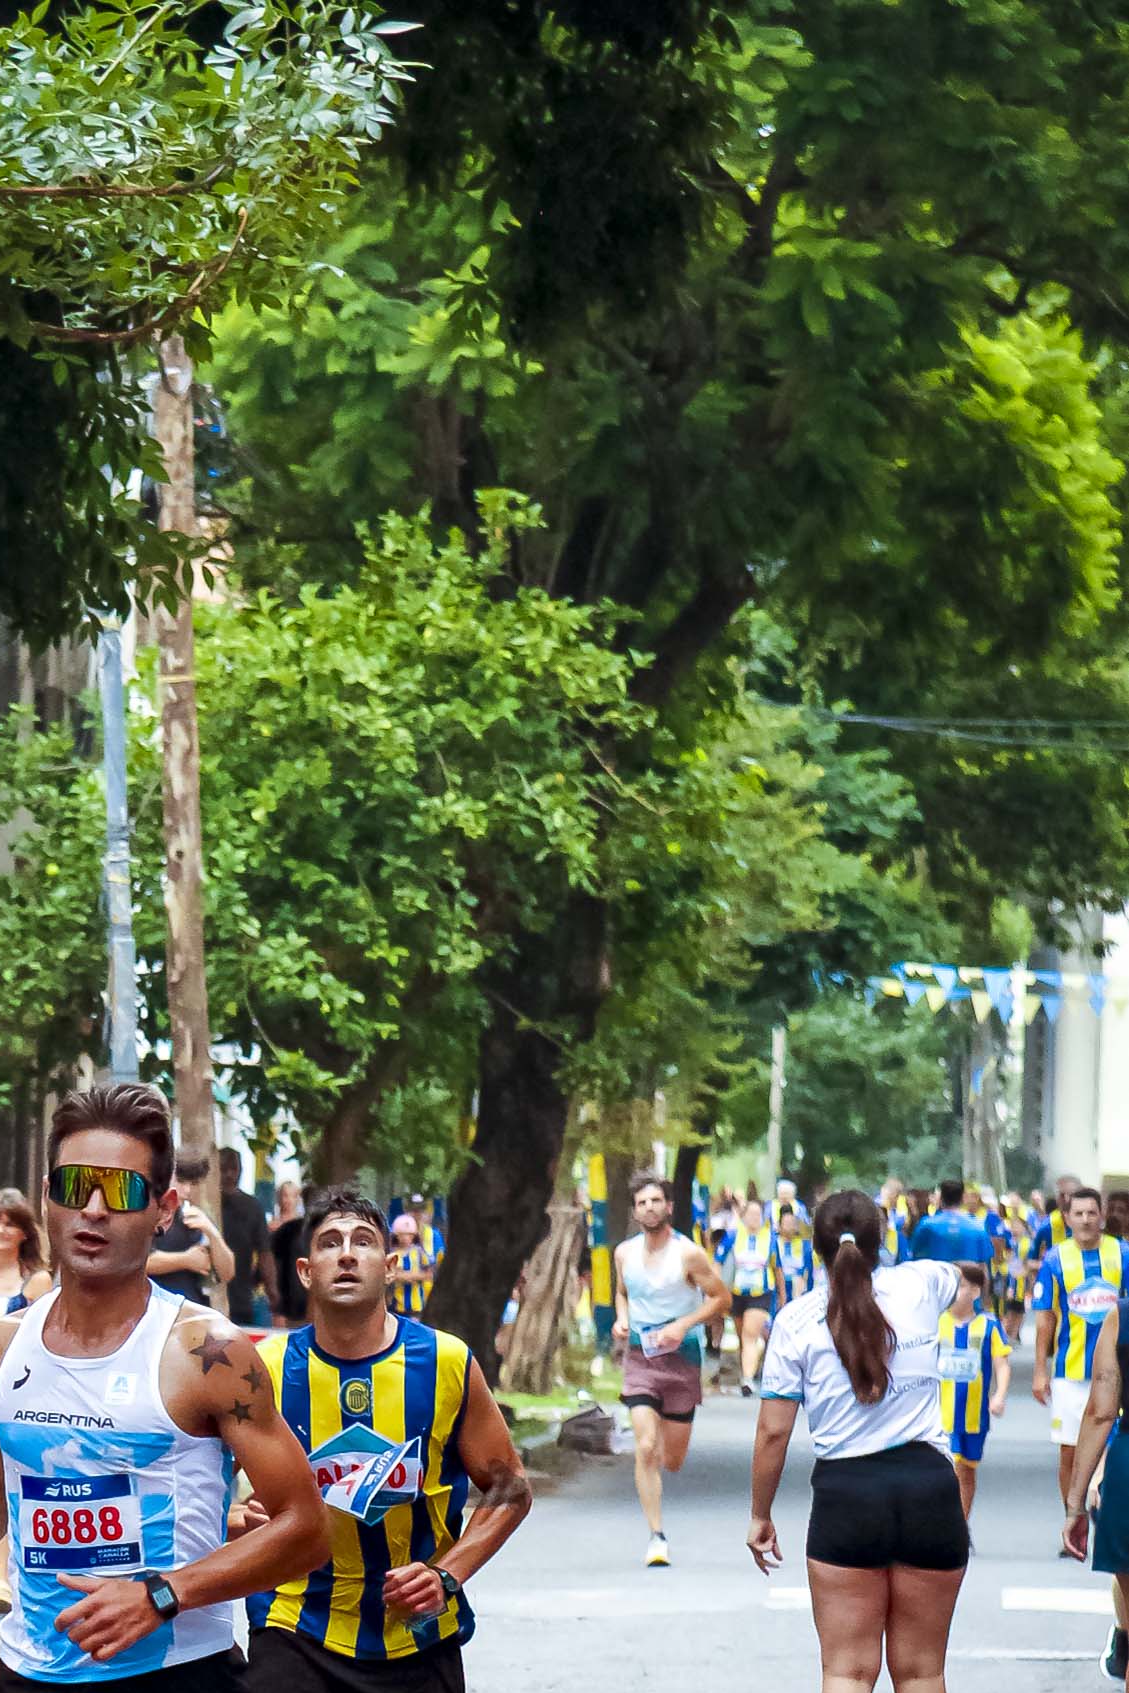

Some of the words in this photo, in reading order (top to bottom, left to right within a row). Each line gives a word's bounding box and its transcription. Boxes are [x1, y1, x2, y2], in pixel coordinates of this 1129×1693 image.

[13, 1410, 115, 1429] ARGENTINA
[62, 1483, 92, 1497] RUS
[32, 1506, 124, 1545] 6888
[29, 1551, 48, 1565] 5K
